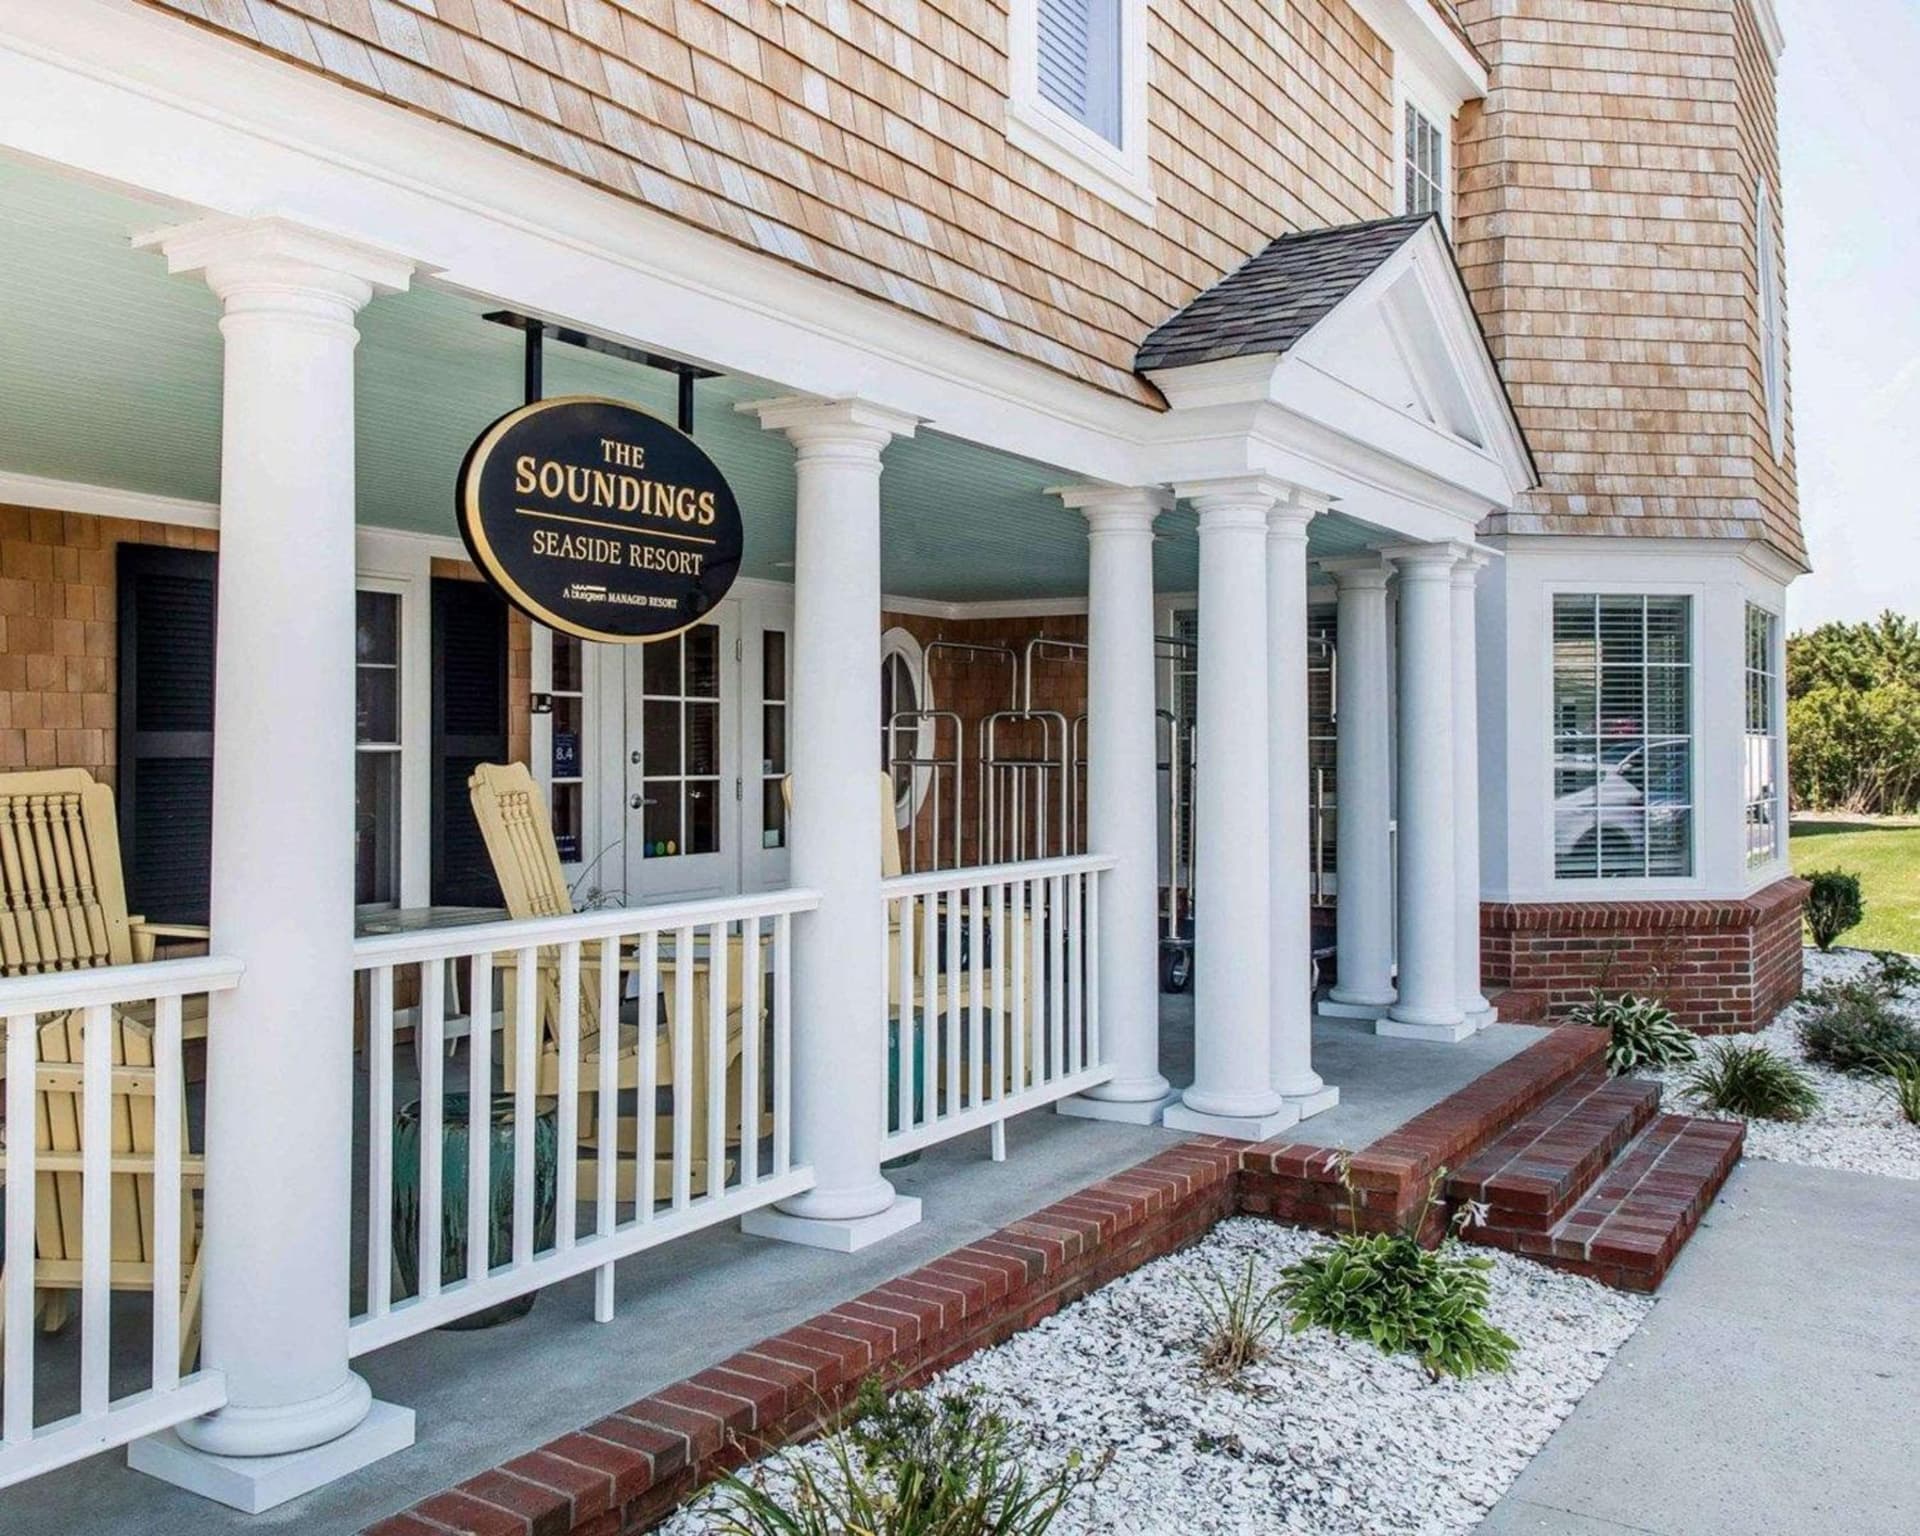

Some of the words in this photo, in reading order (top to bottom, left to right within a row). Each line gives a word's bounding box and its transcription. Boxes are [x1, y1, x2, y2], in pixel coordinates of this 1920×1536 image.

[601, 438, 645, 469] THE
[515, 456, 716, 525] SOUNDINGS
[532, 530, 621, 565] SEASIDE
[629, 544, 703, 575] RESORT
[608, 593, 648, 606] MANAGED
[649, 597, 678, 609] RESORT
[556, 747, 573, 761] 8.4
